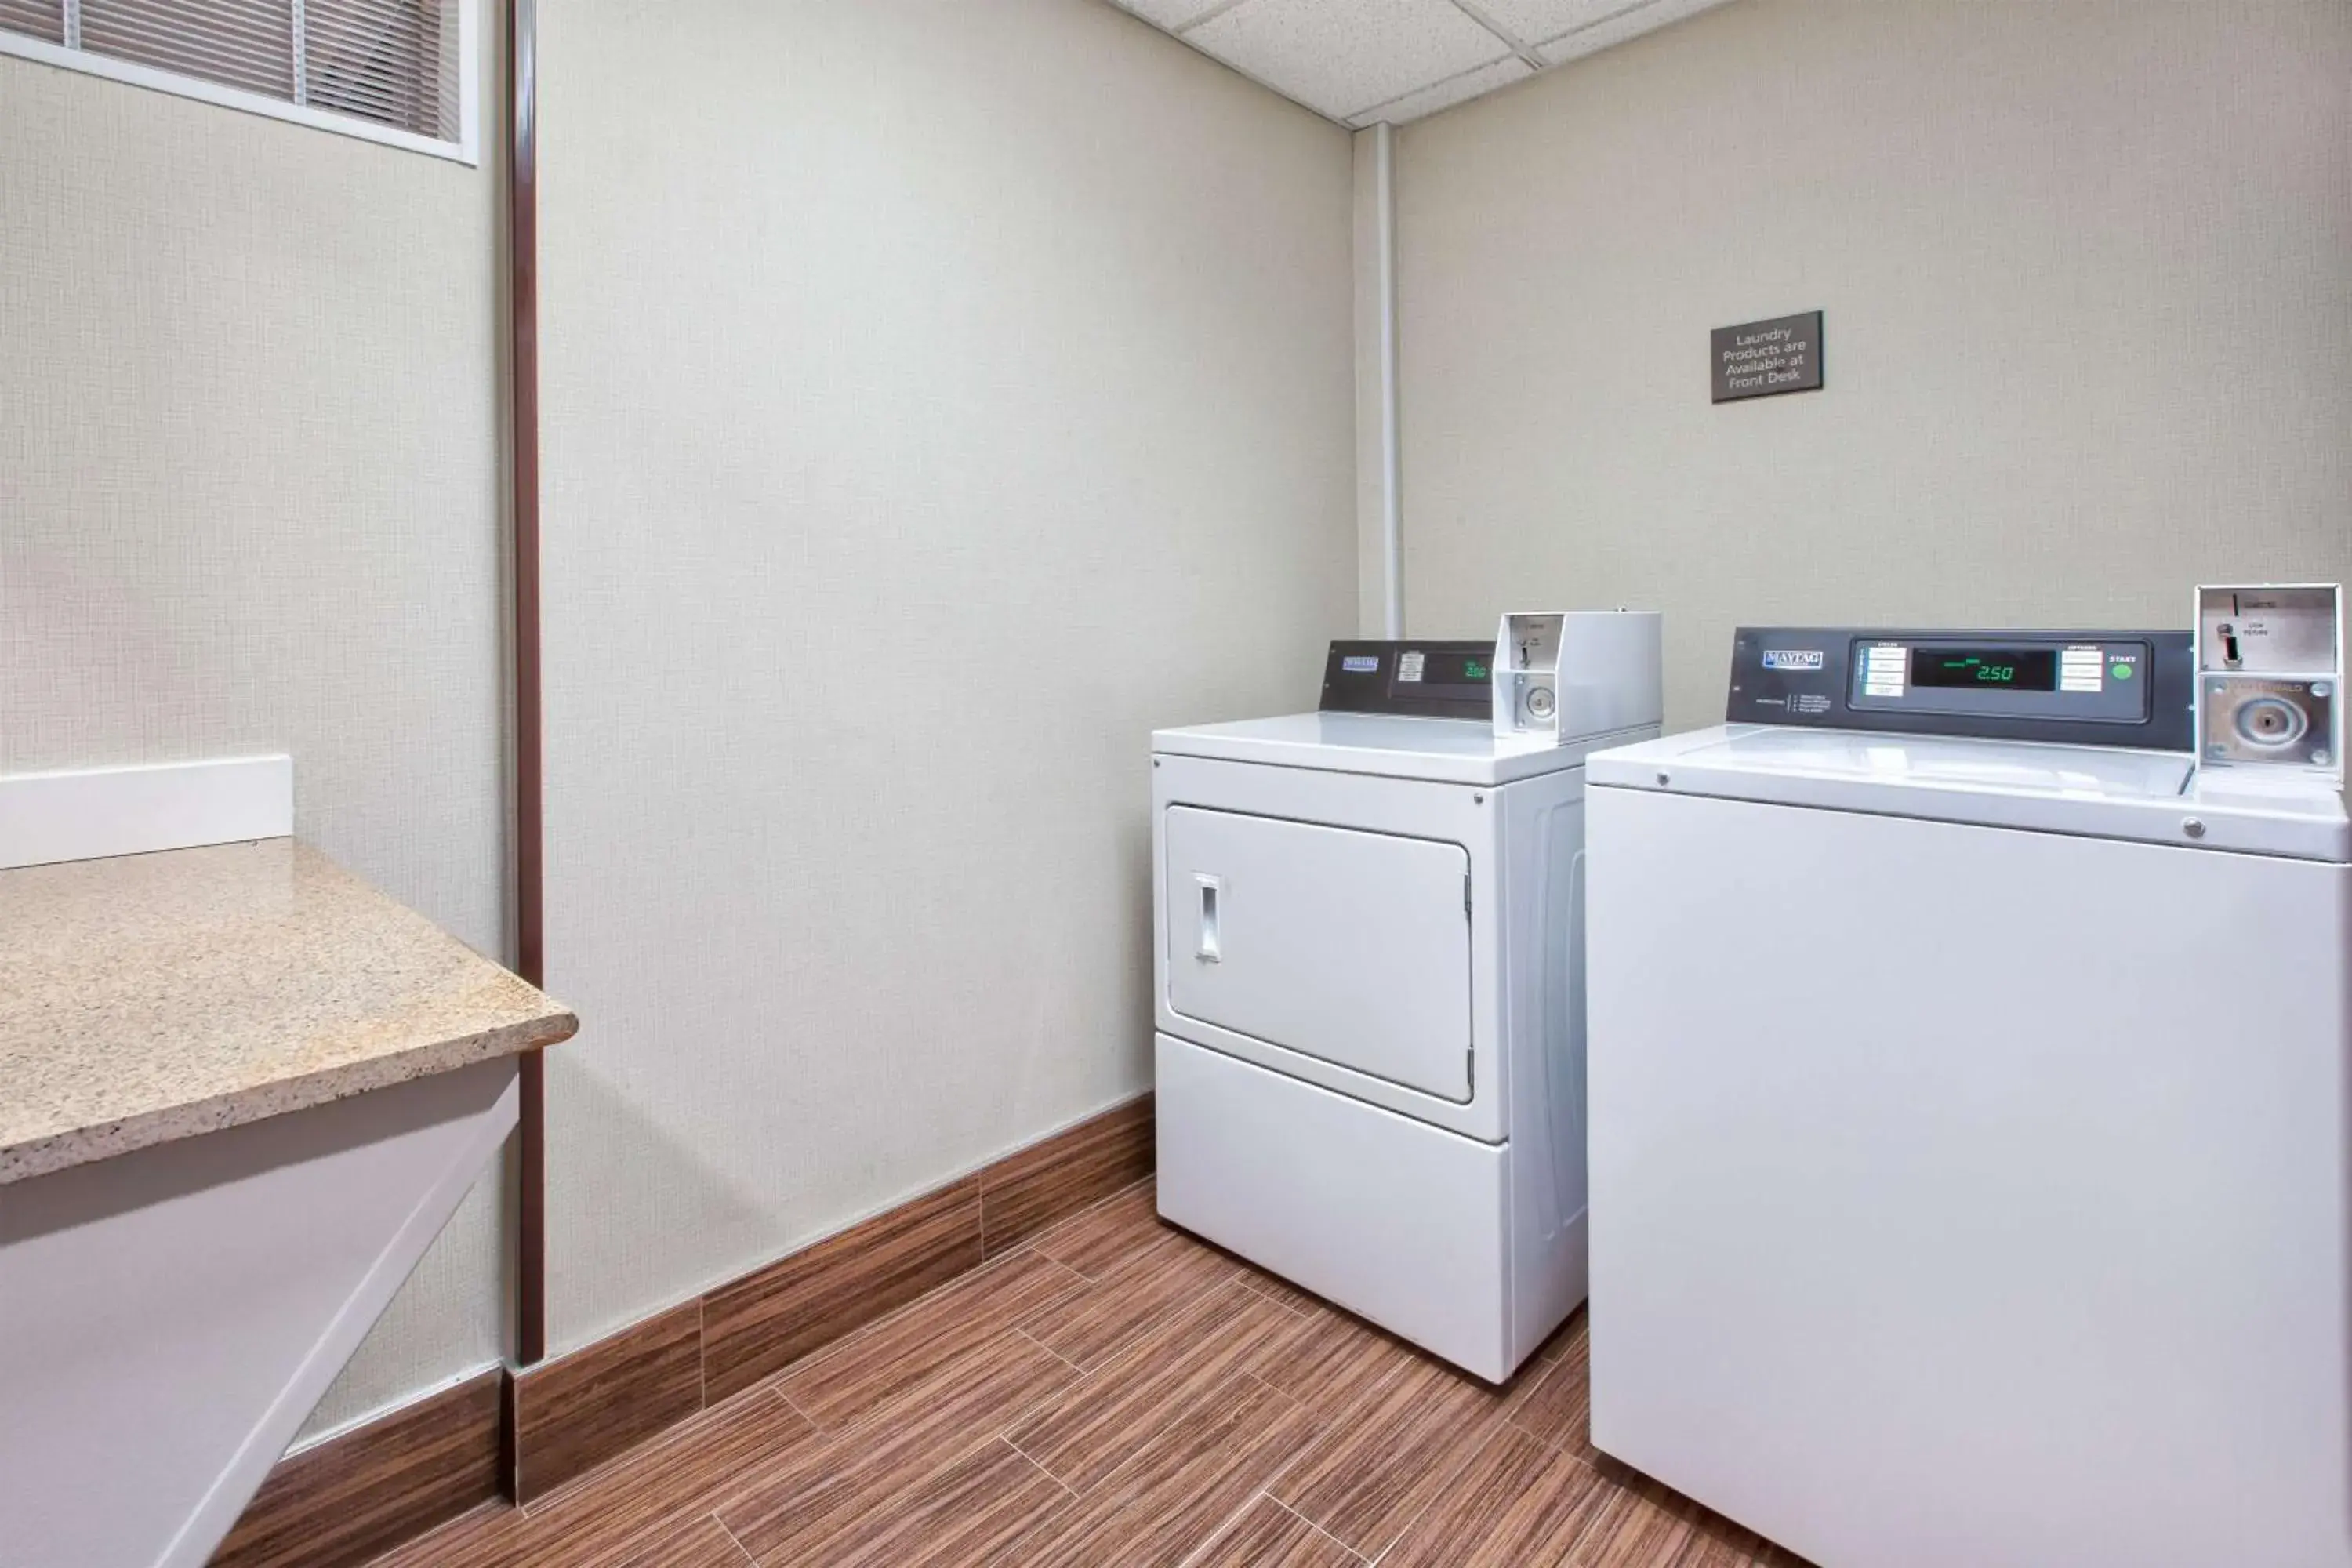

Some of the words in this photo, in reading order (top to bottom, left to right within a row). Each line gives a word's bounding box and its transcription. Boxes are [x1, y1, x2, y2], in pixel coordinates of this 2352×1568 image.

[1737, 328, 1791, 345] Laundry
[1722, 345, 1780, 362] Products
[1784, 340, 1807, 353] are
[1726, 358, 1786, 376] Available
[1790, 354, 1805, 366] at
[1729, 374, 1762, 388] Front
[1768, 368, 1800, 383] Desk
[1766, 652, 1819, 666] MAYTAG
